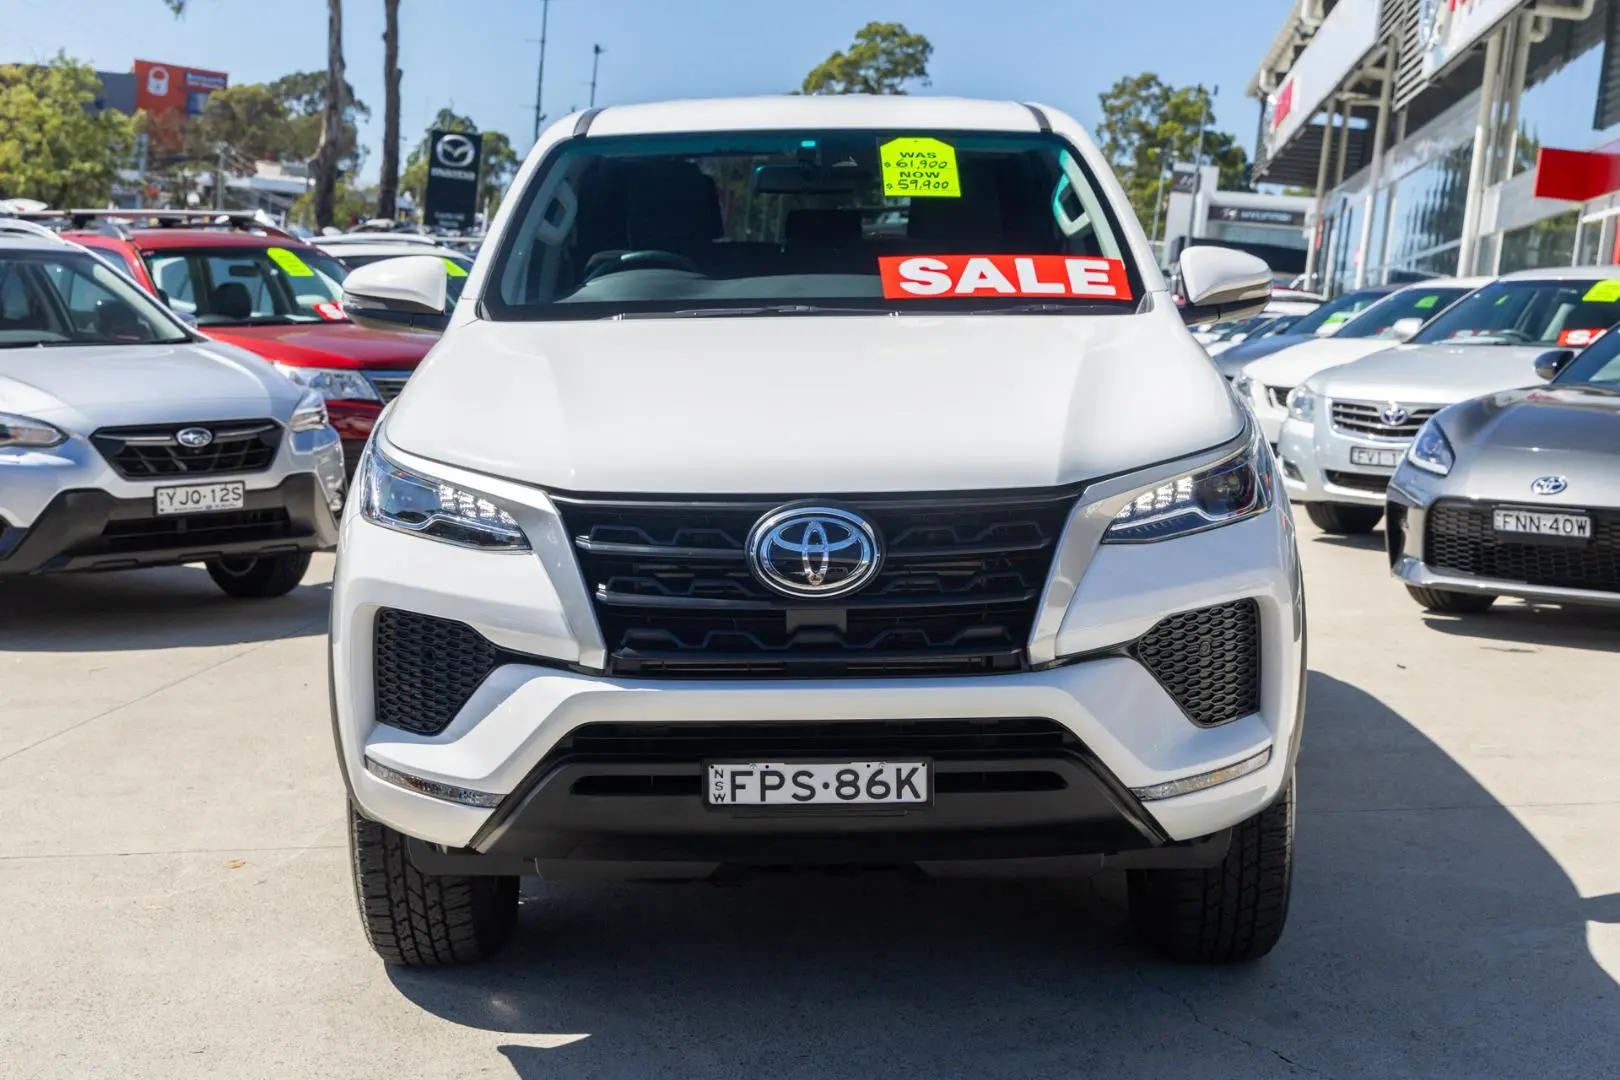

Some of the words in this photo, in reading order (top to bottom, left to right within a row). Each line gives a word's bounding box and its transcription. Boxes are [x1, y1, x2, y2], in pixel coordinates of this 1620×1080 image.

[896, 159, 948, 170] 61,900
[898, 178, 949, 190] 59,900
[898, 257, 1116, 296] SALE
